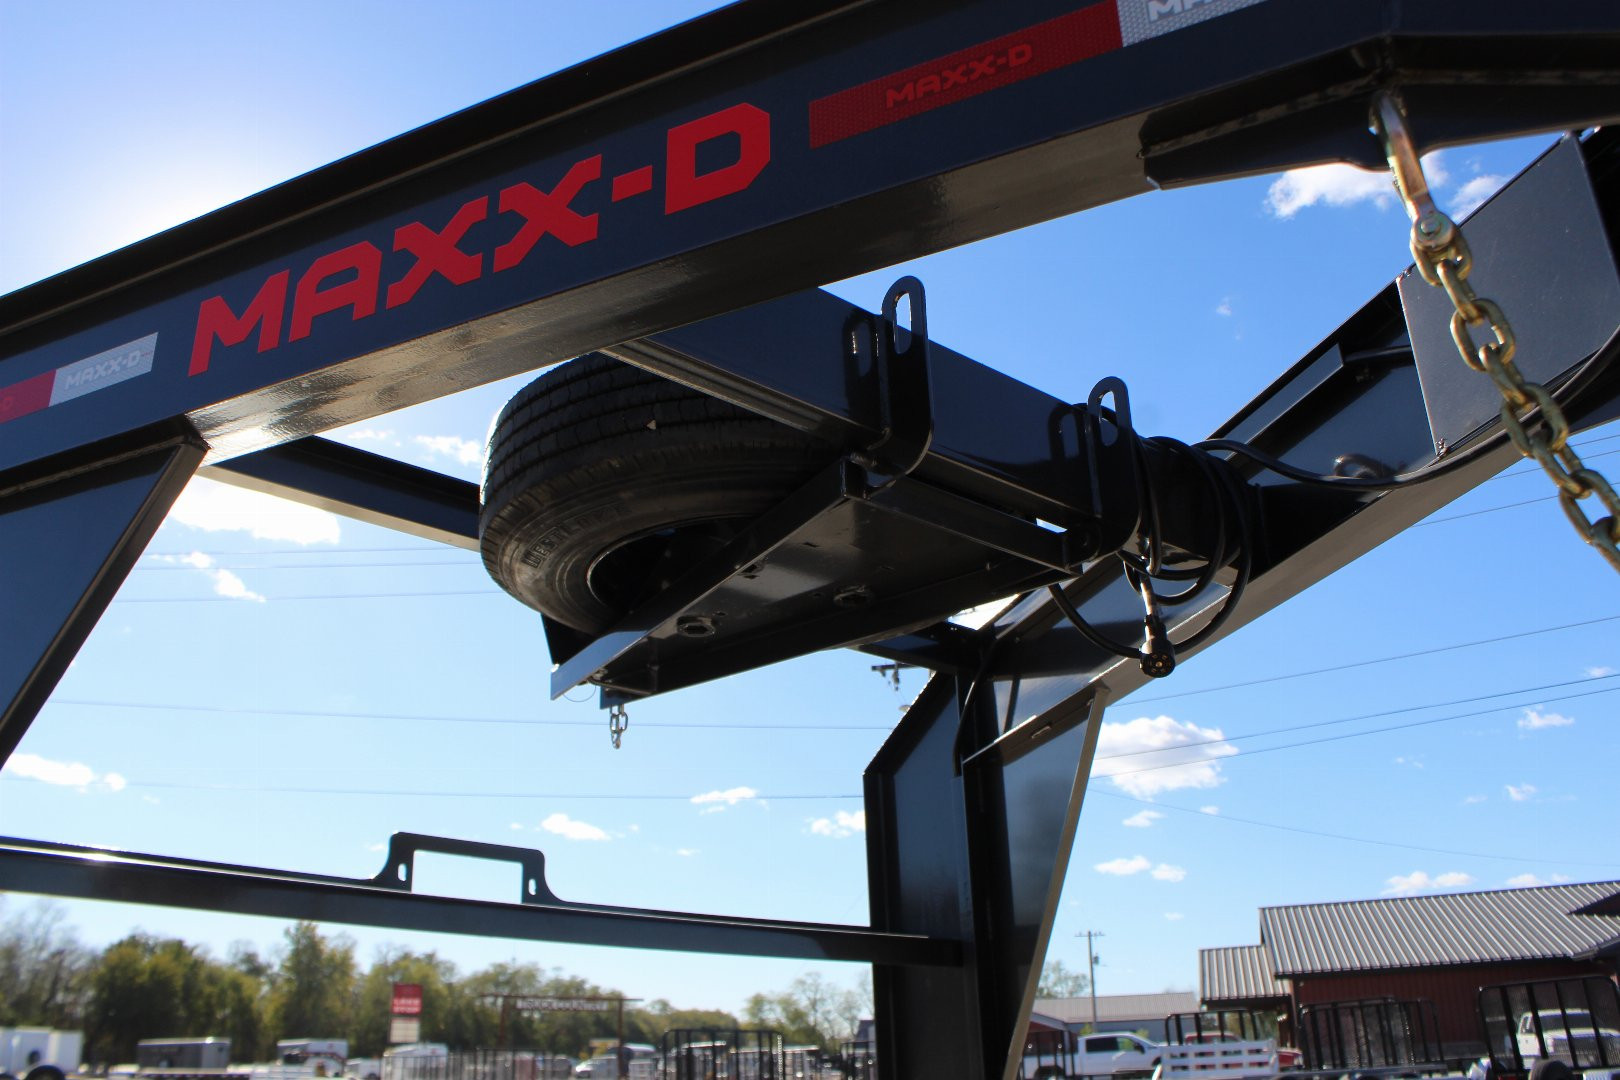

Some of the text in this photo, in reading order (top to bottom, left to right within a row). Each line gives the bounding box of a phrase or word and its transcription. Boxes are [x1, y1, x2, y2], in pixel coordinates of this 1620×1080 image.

[886, 44, 1033, 108] MAXX-D
[188, 102, 770, 377] MAXX-D
[65, 350, 142, 389] MAXX-D
